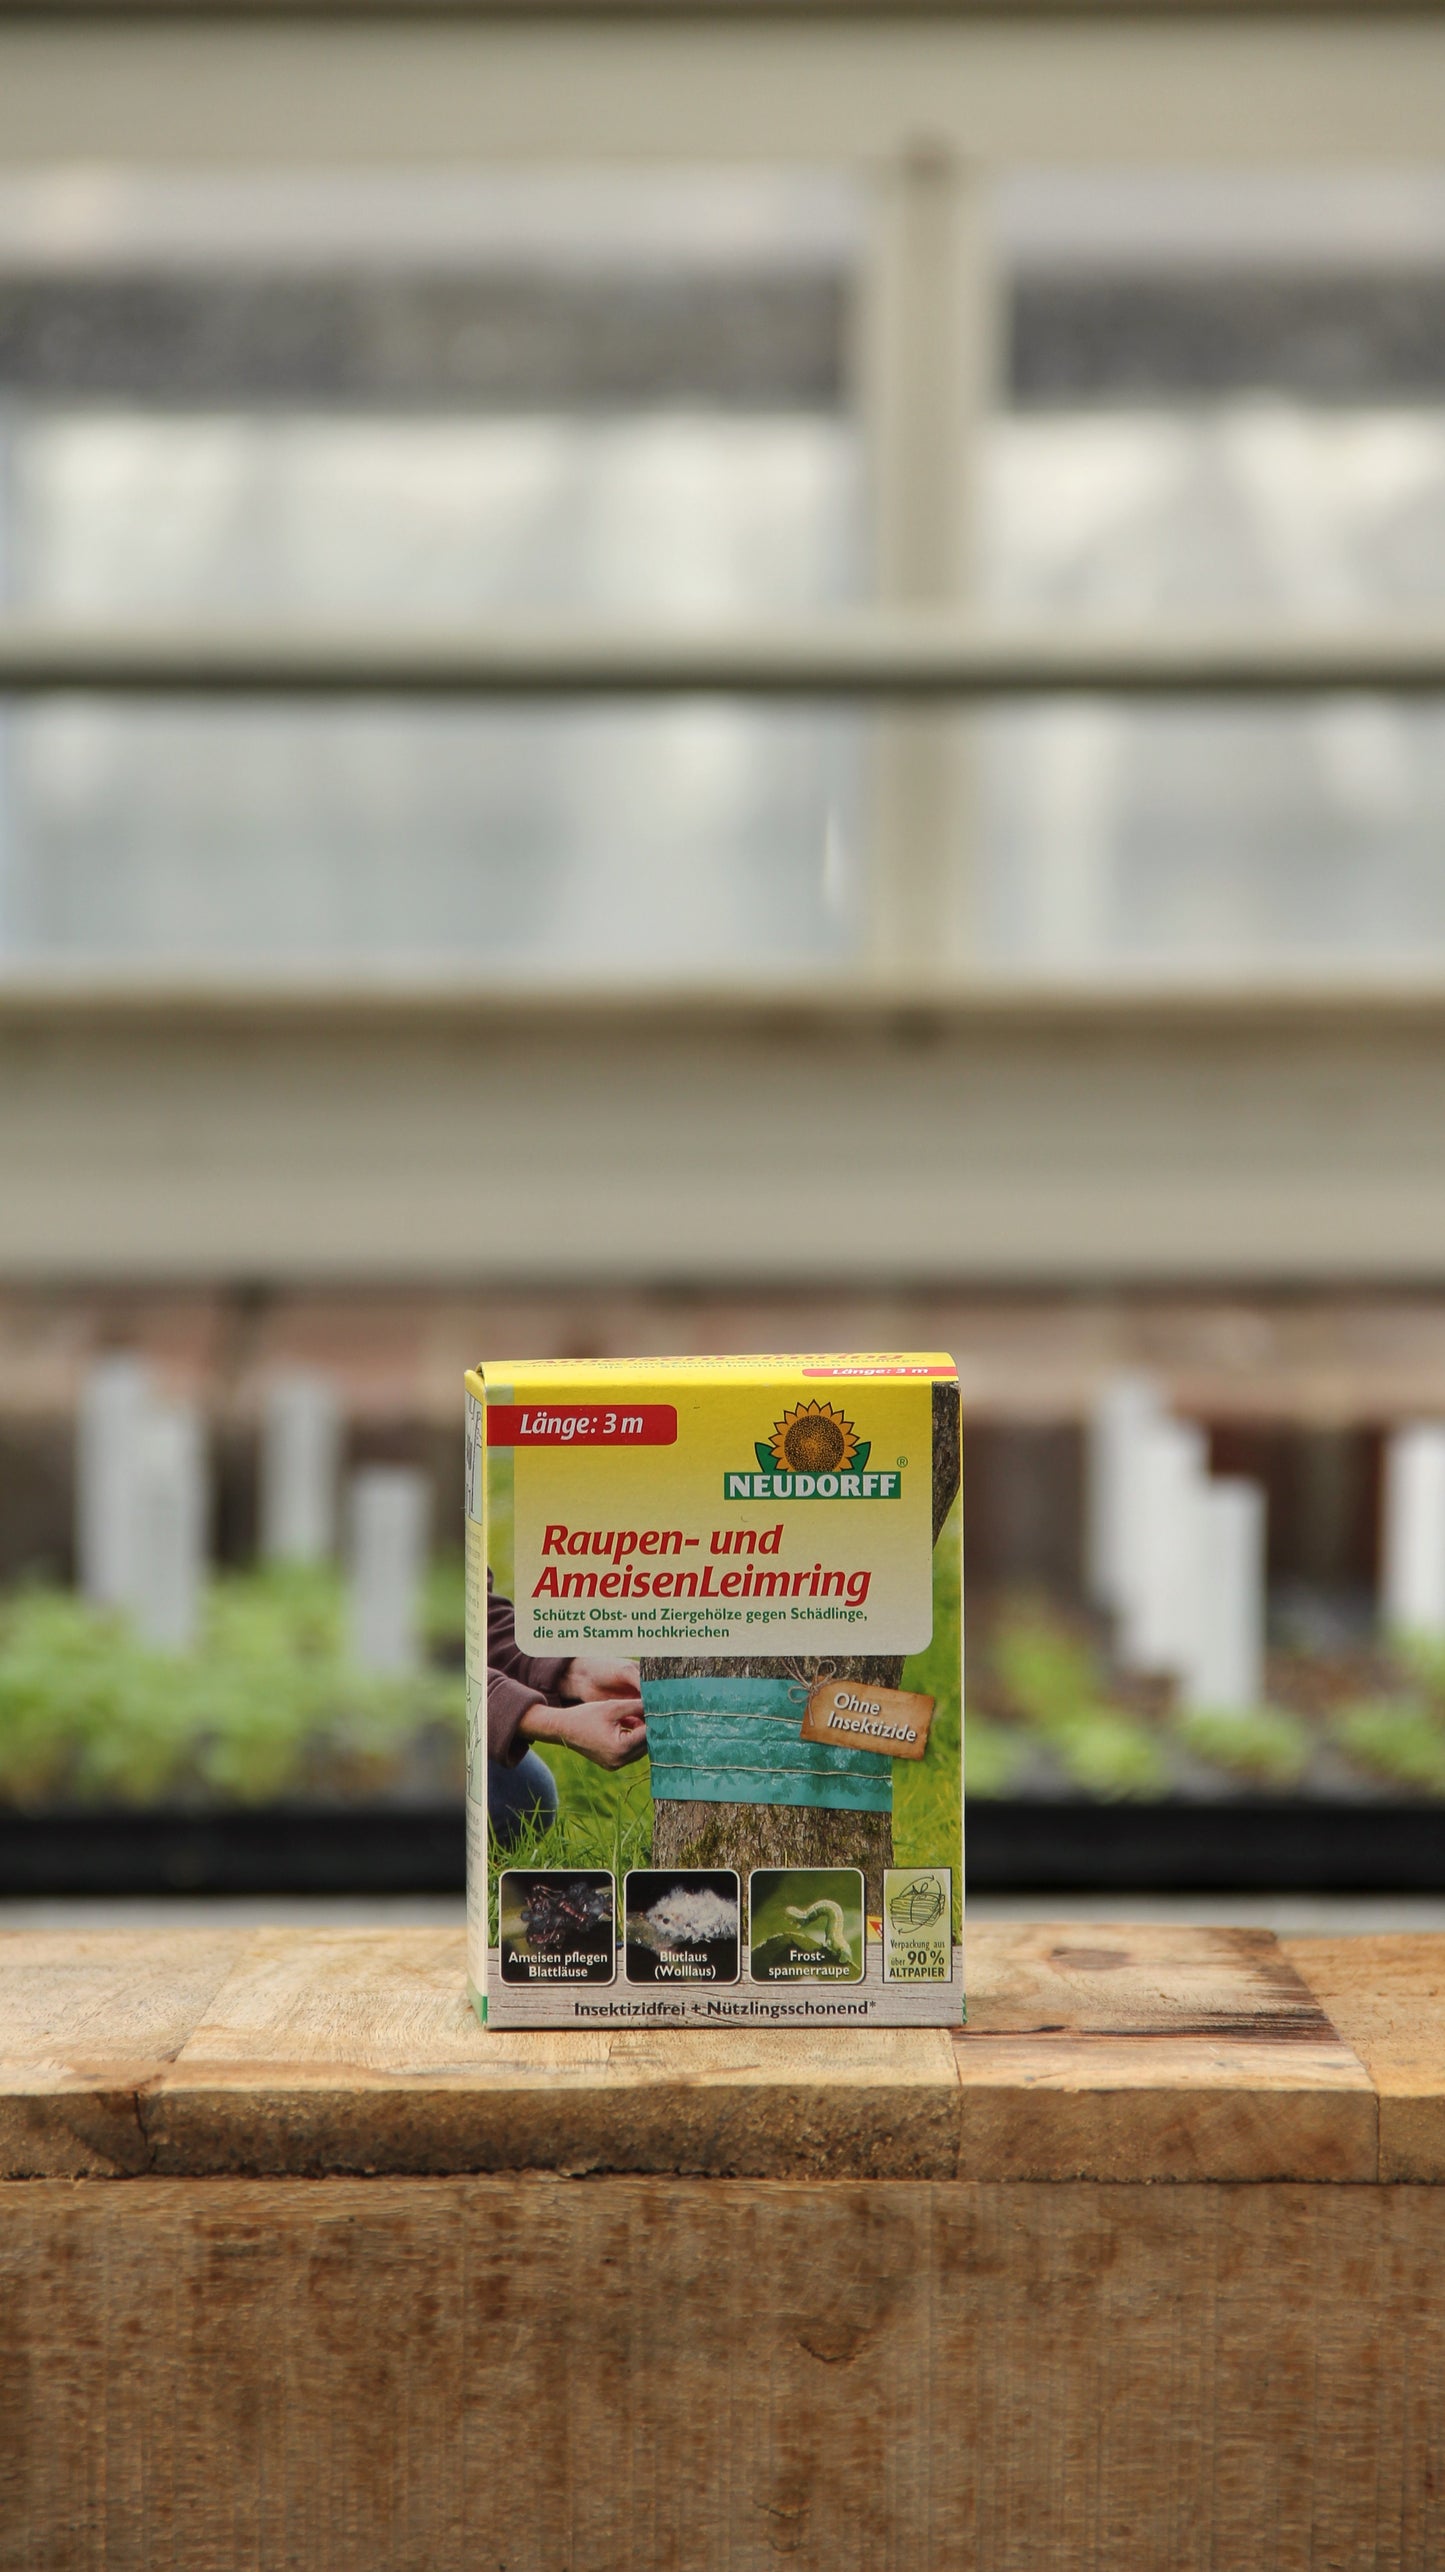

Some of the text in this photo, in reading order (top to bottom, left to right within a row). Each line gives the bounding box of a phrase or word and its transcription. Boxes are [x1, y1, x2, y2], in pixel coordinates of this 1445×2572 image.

[832, 1368, 893, 1376] Länge:
[519, 1412, 643, 1440] Länge: 3 m
[729, 1473, 897, 1497] NEUDORFF
[542, 1525, 784, 1564] Raupen- und
[532, 1564, 871, 1606] AmeisenLeimring
[533, 1607, 867, 1624] Schützt Obst- und Ziergehölze gegen Schädlinge,
[533, 1625, 730, 1638] die am Stamm hochkriechen
[834, 1693, 880, 1715] Ohne
[827, 1713, 917, 1742] Insektizide
[890, 1939, 930, 1951] Verpackung
[508, 1951, 608, 1967] Ameisen pflegen
[660, 1950, 708, 1963] Blutlaus
[790, 1950, 825, 1962] Frost-
[891, 1952, 944, 1966] über 90 %
[528, 1965, 588, 1978] Blattläuse
[654, 1964, 716, 1979] (Wolllaus)
[768, 1966, 850, 1979] spannerraupe
[889, 1967, 945, 1978] ALTPAPIER
[574, 2001, 686, 2016] Insektizidfrei
